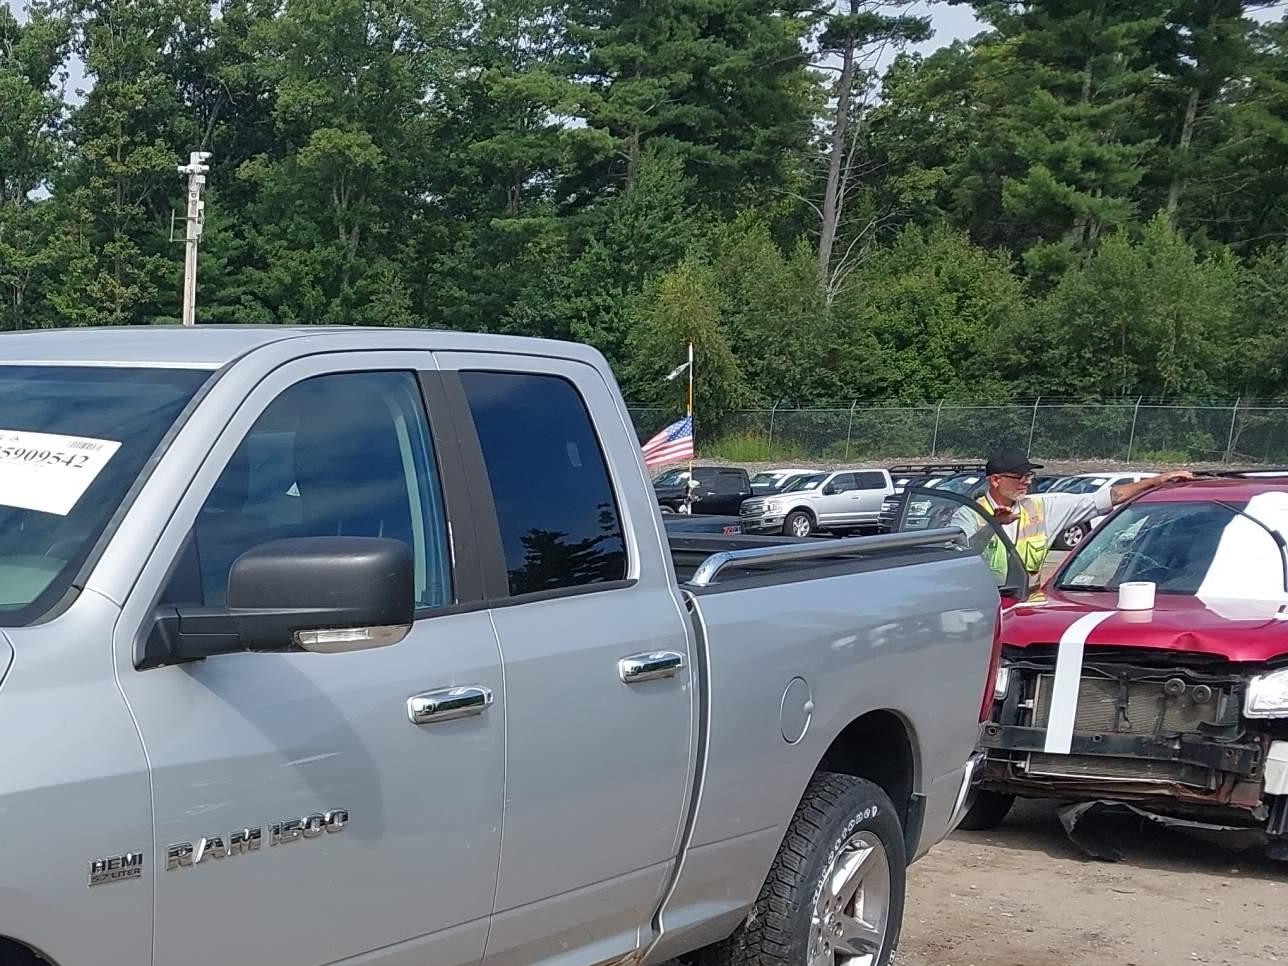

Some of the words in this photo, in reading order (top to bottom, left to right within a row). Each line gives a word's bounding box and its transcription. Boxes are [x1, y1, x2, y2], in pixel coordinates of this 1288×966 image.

[166, 828, 261, 871] RAM
[268, 808, 349, 847] 1500
[91, 853, 143, 873] HEMI
[111, 868, 142, 879] LITER
